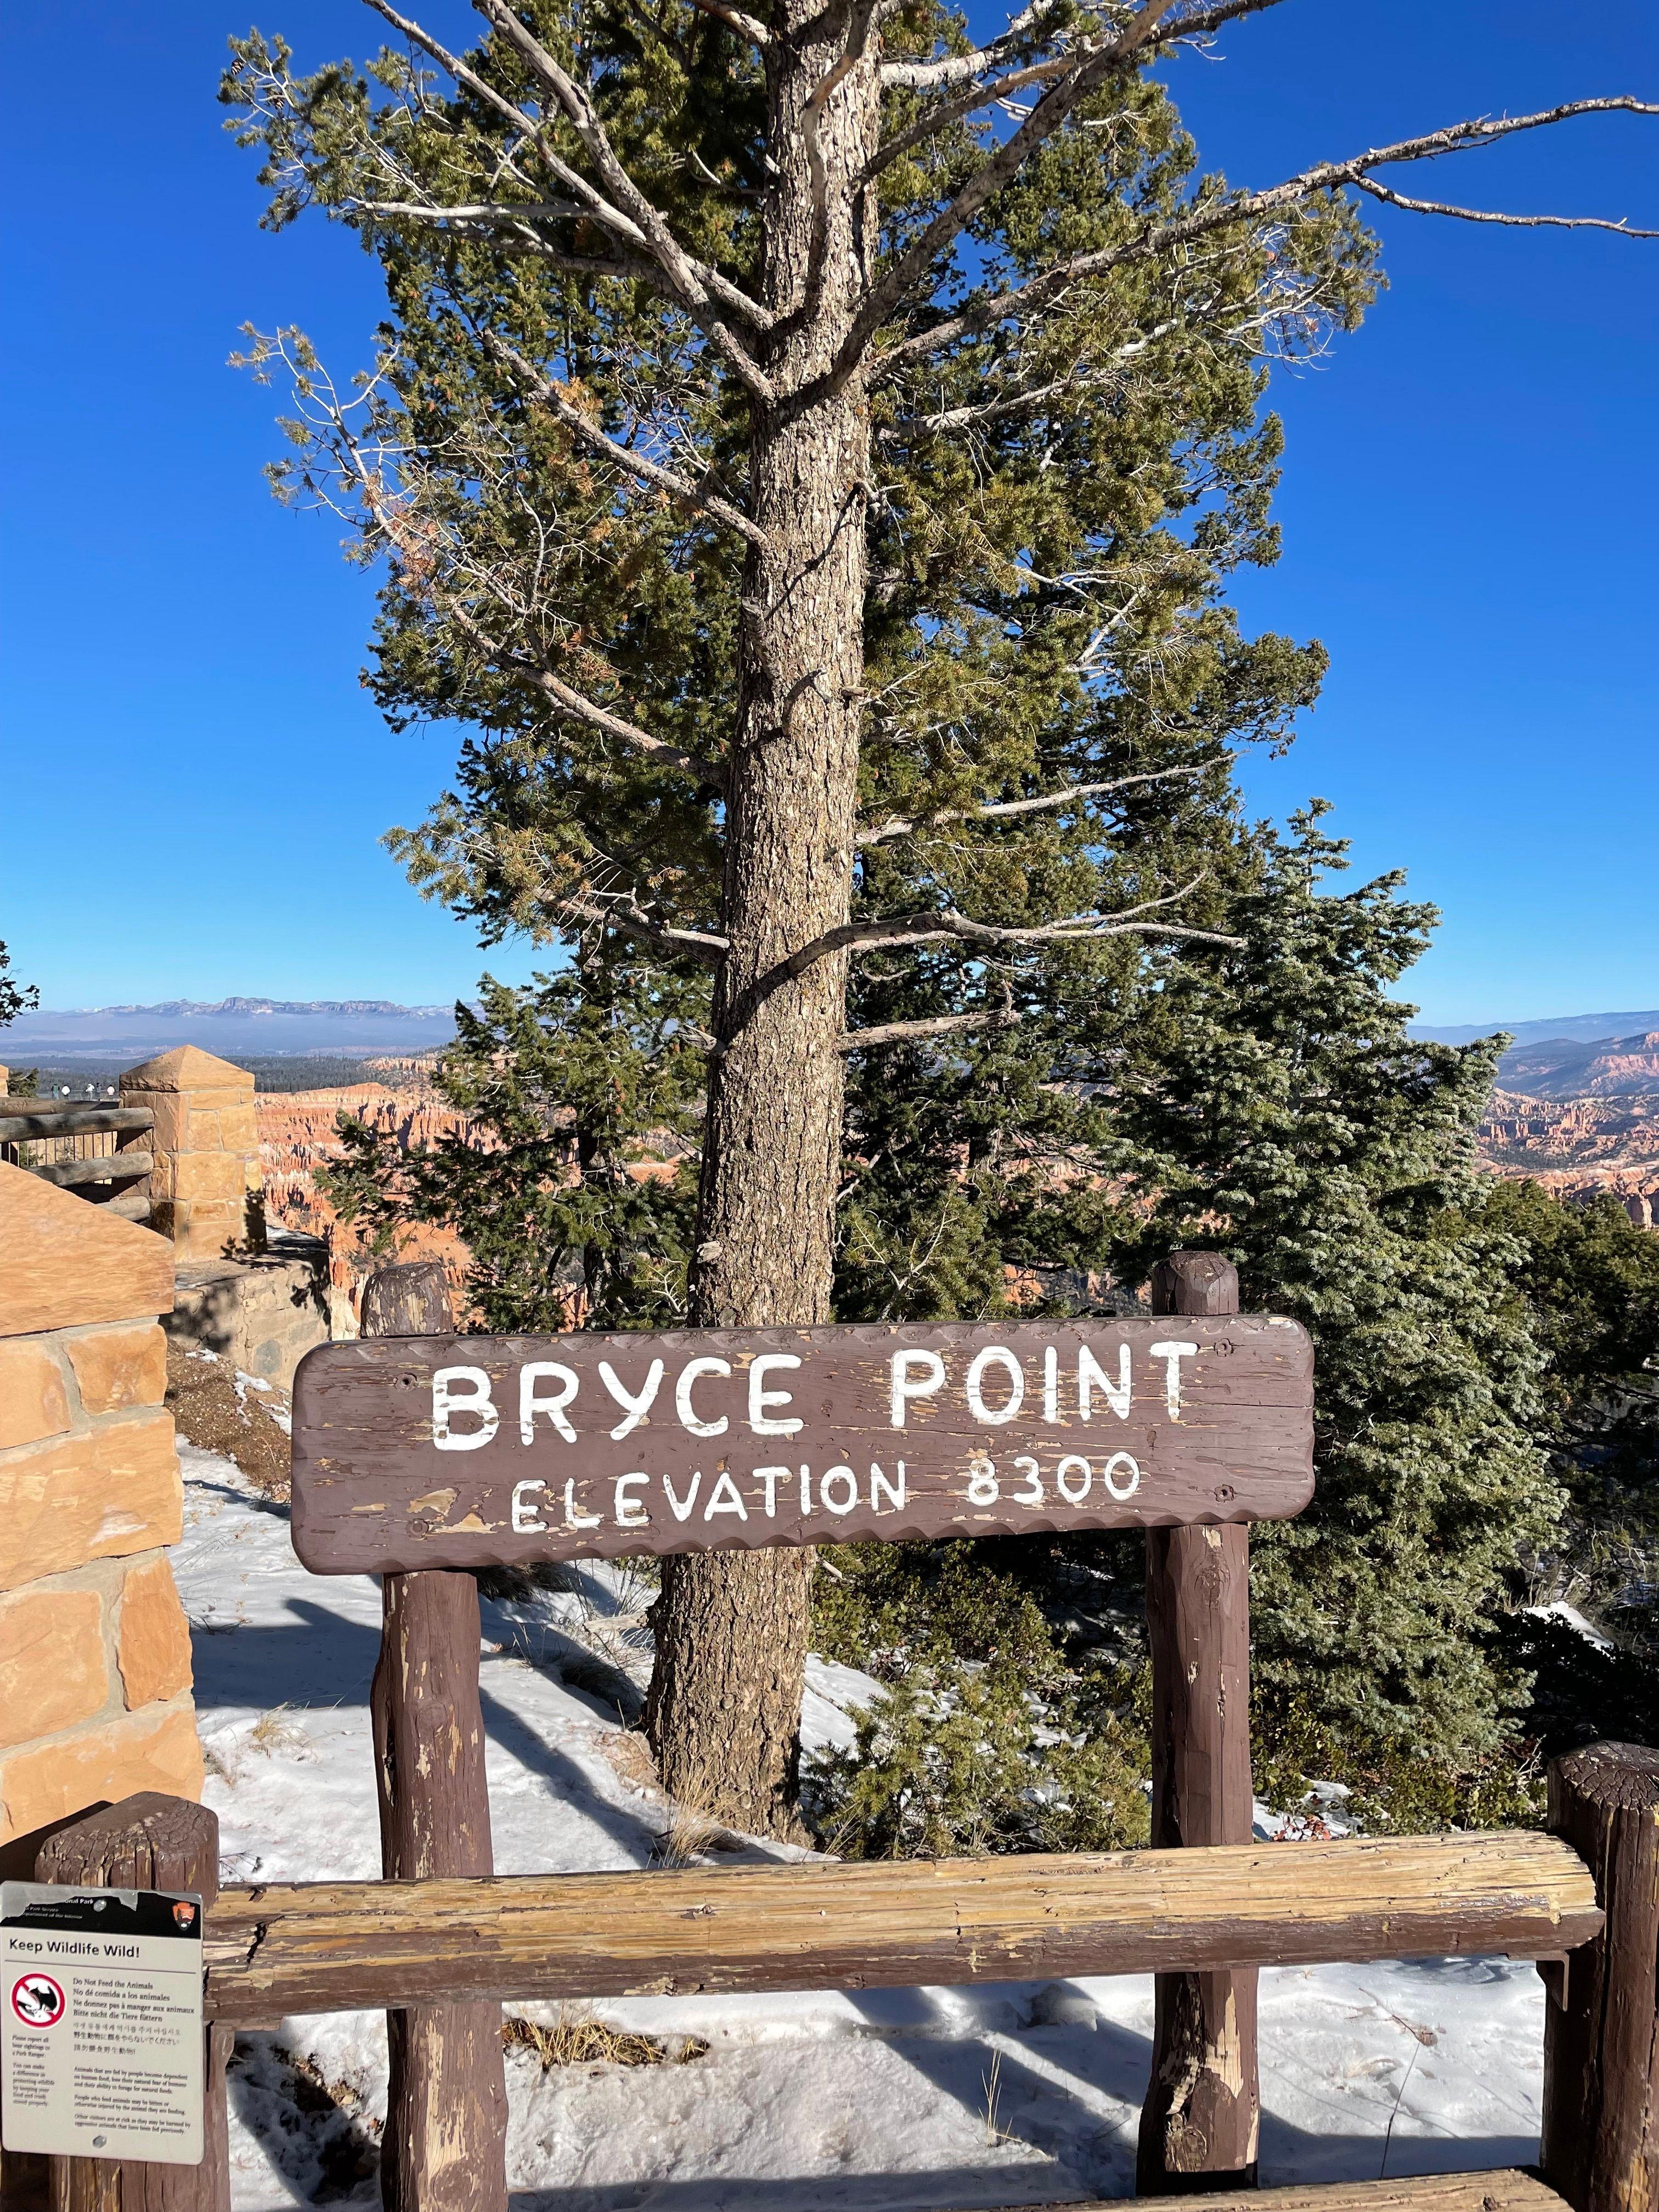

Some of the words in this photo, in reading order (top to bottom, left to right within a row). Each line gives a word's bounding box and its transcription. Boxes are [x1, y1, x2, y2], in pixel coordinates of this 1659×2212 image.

[432, 1353, 805, 1452] BRYCE
[890, 1340, 1200, 1428] POINT
[511, 1459, 907, 1534] ELEVATION
[968, 1451, 1140, 1508] 8300
[9, 1939, 43, 1954] Keep
[47, 1941, 99, 1955] Wildlife
[104, 1945, 140, 1958] Wild!
[126, 1981, 153, 1990] Animals
[85, 1988, 93, 1996] dé
[94, 1990, 120, 1999] comida
[127, 1991, 138, 2000] los
[139, 1993, 170, 2002] animales
[83, 2000, 108, 2008] donnez
[127, 2004, 151, 2012] manger
[166, 2006, 195, 2014] animaux
[74, 2009, 89, 2017] Bitte
[121, 2012, 138, 2021] Tiere
[139, 2013, 163, 2023] füttern
